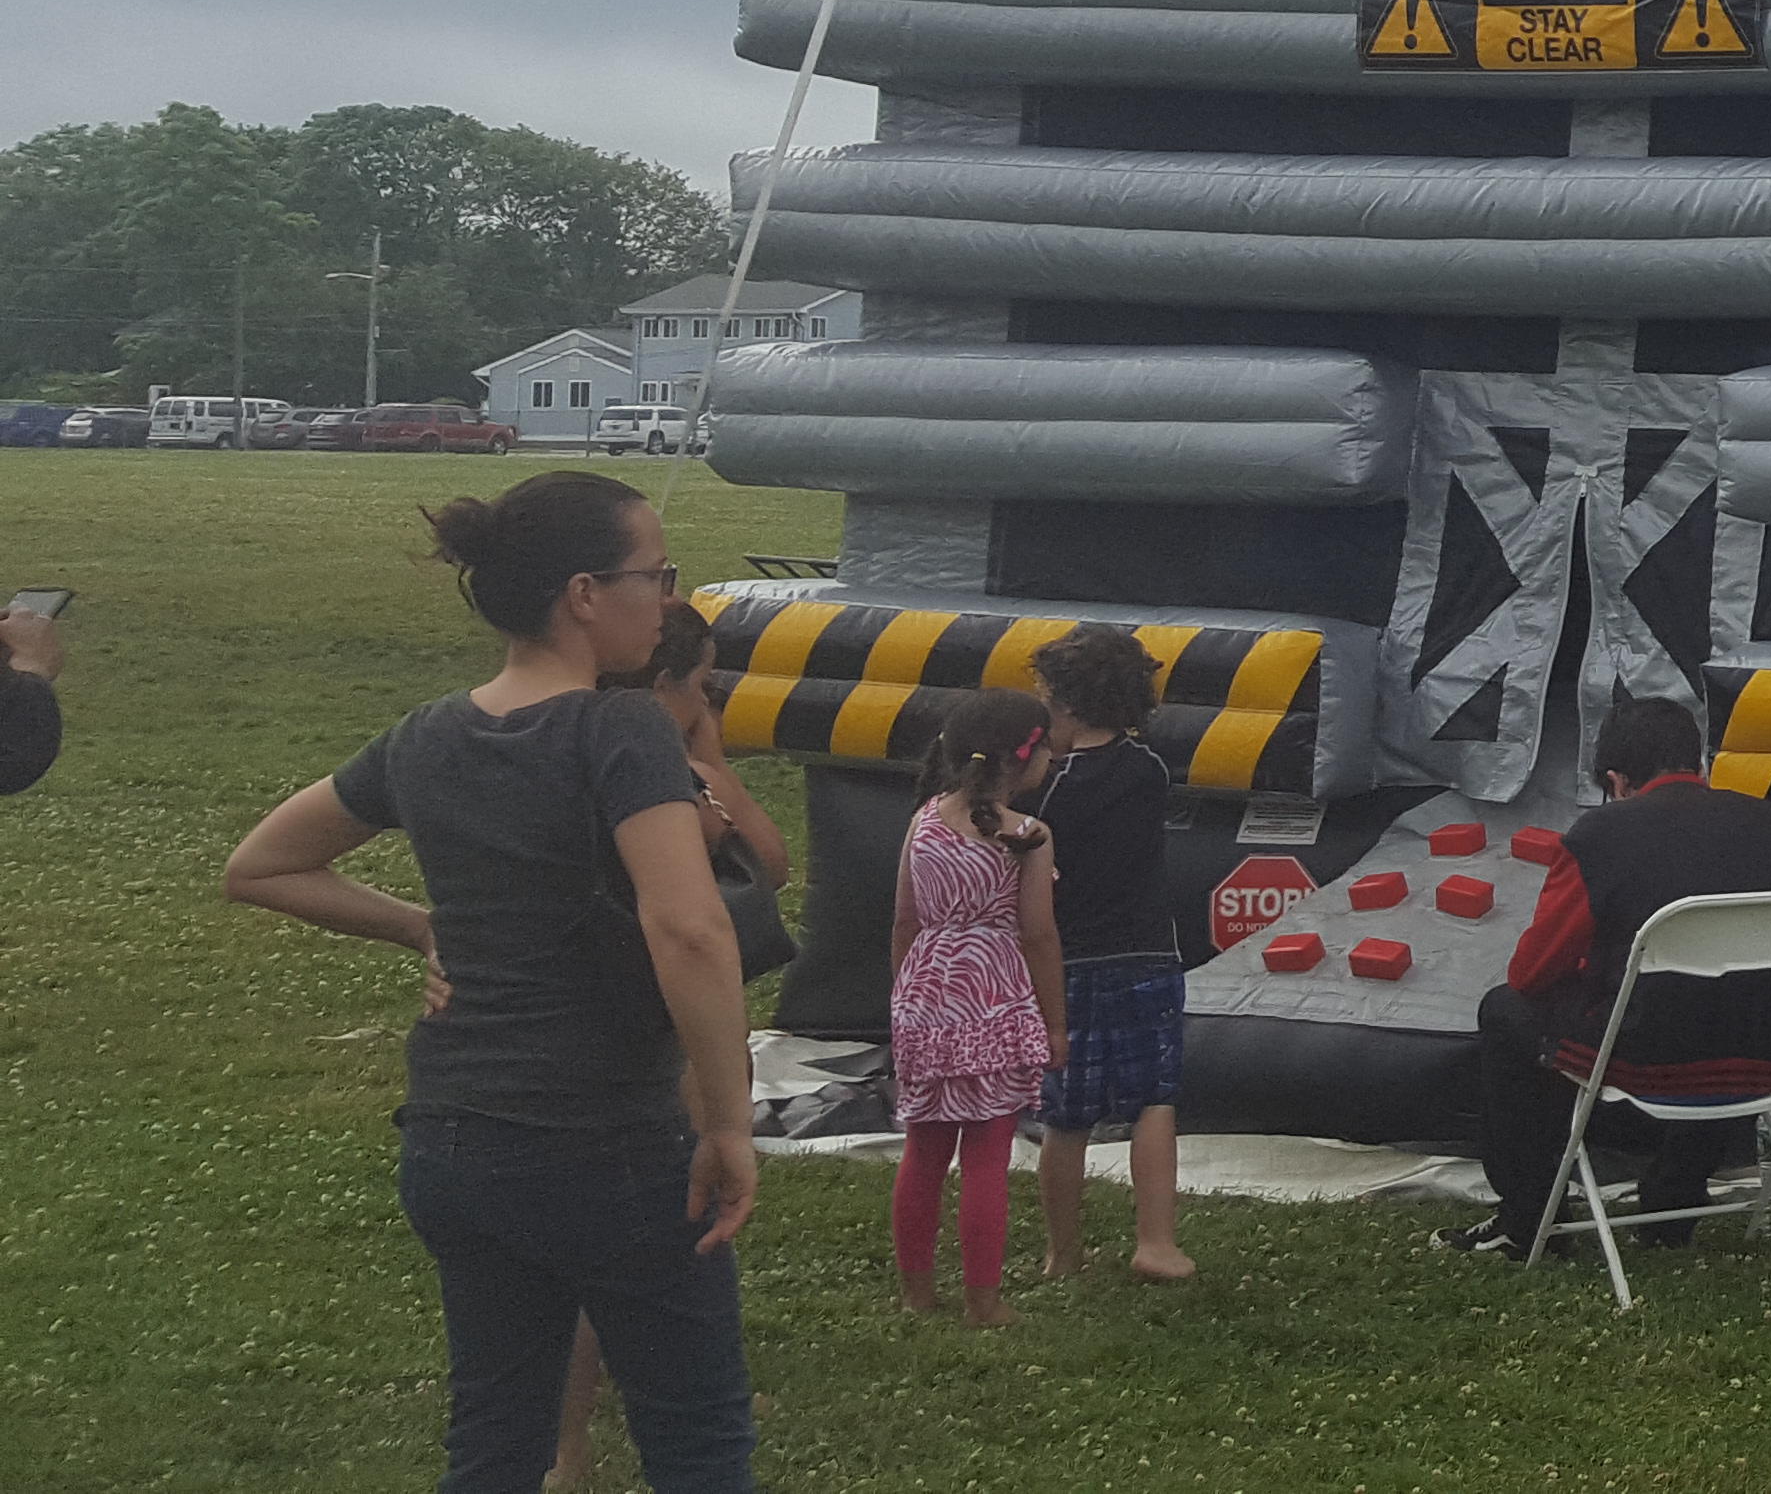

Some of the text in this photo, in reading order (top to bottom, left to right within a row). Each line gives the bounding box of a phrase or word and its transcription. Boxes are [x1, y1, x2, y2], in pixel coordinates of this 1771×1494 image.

[1518, 8, 1589, 34] STAY
[1506, 36, 1604, 63] CLEAR
[1227, 922, 1244, 933] DO
